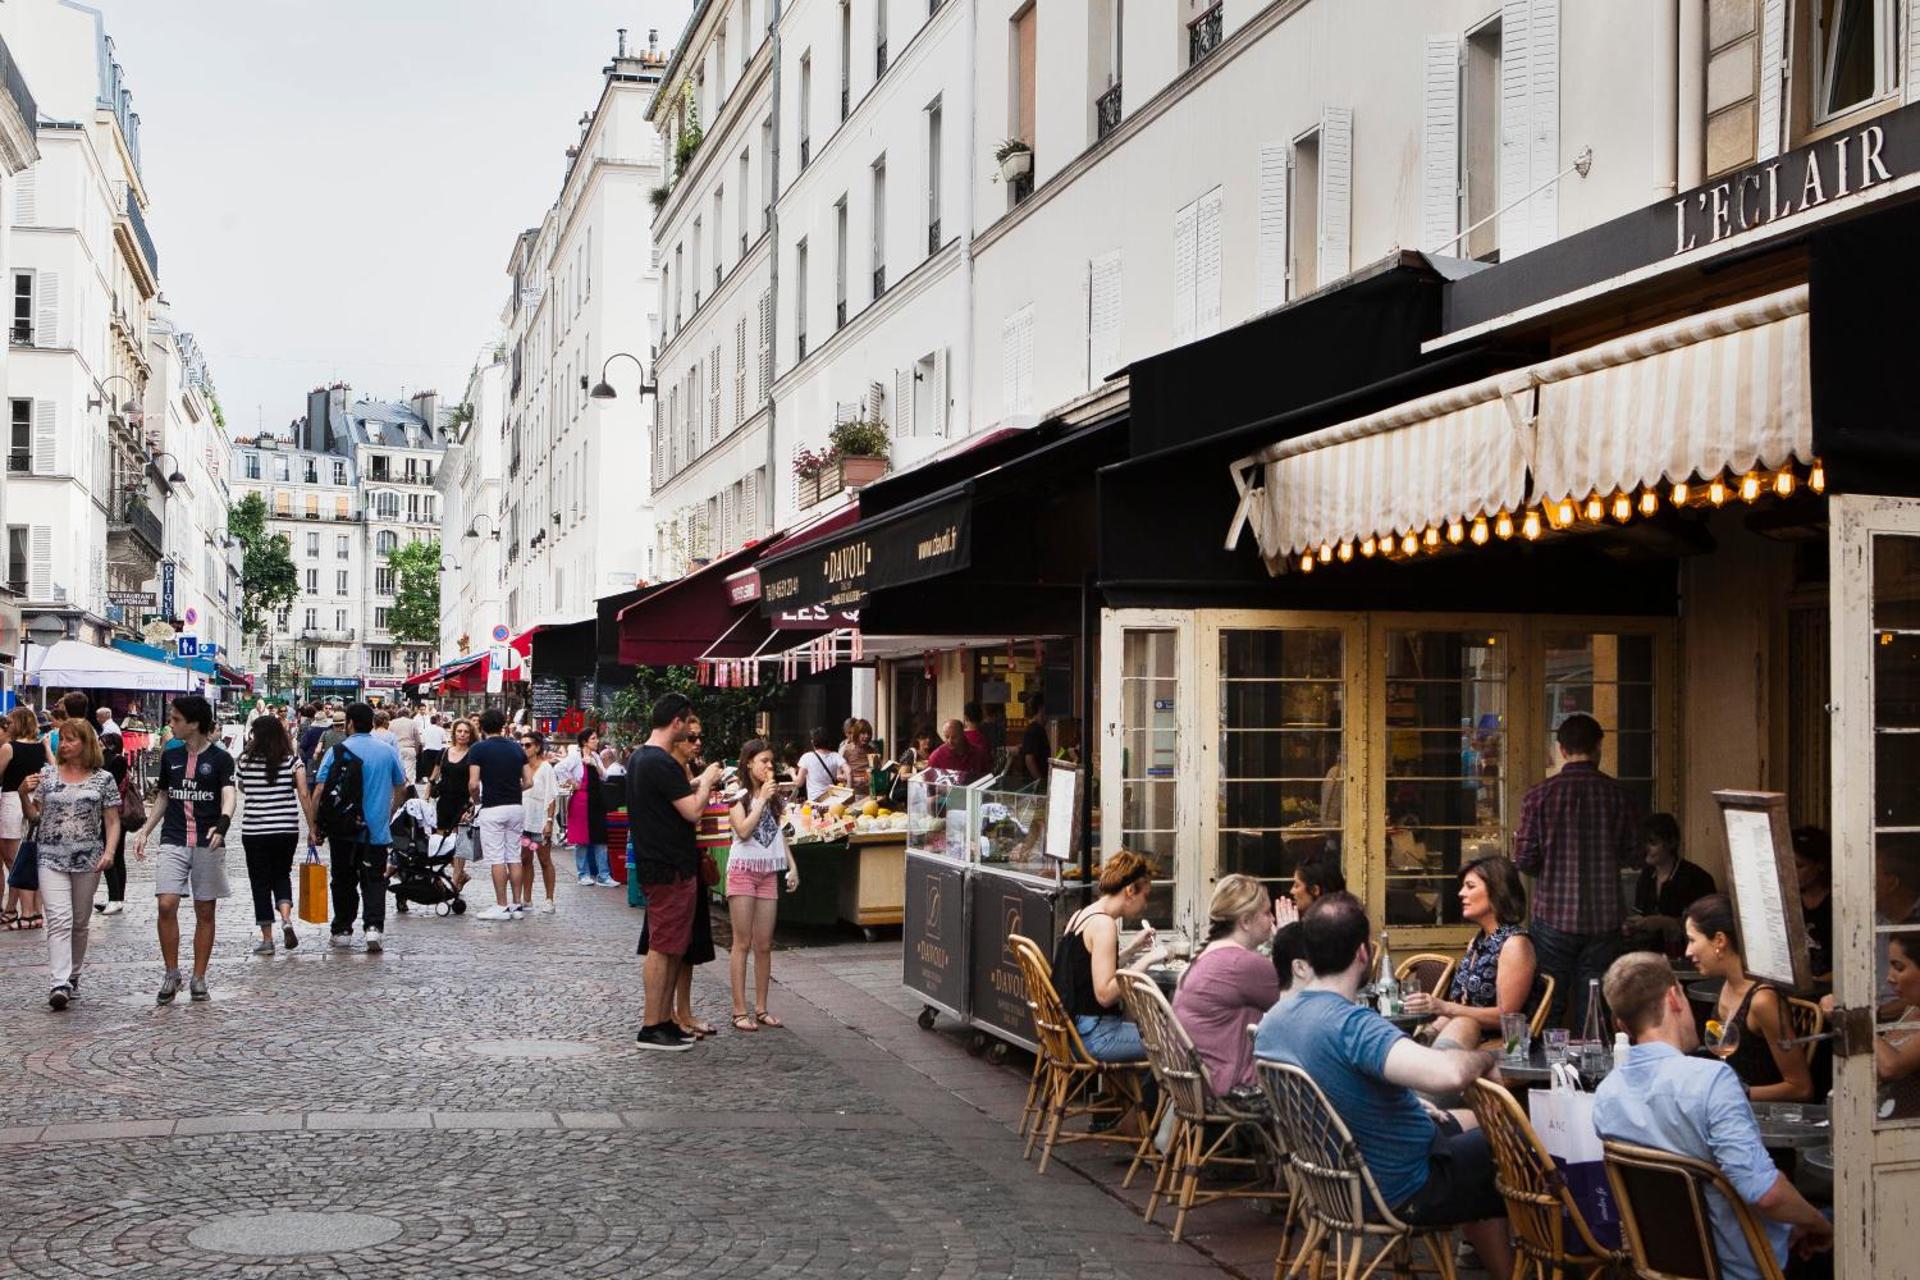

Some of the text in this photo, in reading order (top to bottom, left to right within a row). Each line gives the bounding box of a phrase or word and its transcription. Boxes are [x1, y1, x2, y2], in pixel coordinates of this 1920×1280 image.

[1674, 126, 1893, 256] L'ECLAIR
[918, 525, 957, 560] www.davoli.fr
[829, 541, 866, 583] DAVOLI
[164, 565, 174, 617] OPTIQUE
[168, 786, 215, 801] Emirates
[182, 779, 197, 790] Fly
[920, 940, 945, 969] DAVOLI
